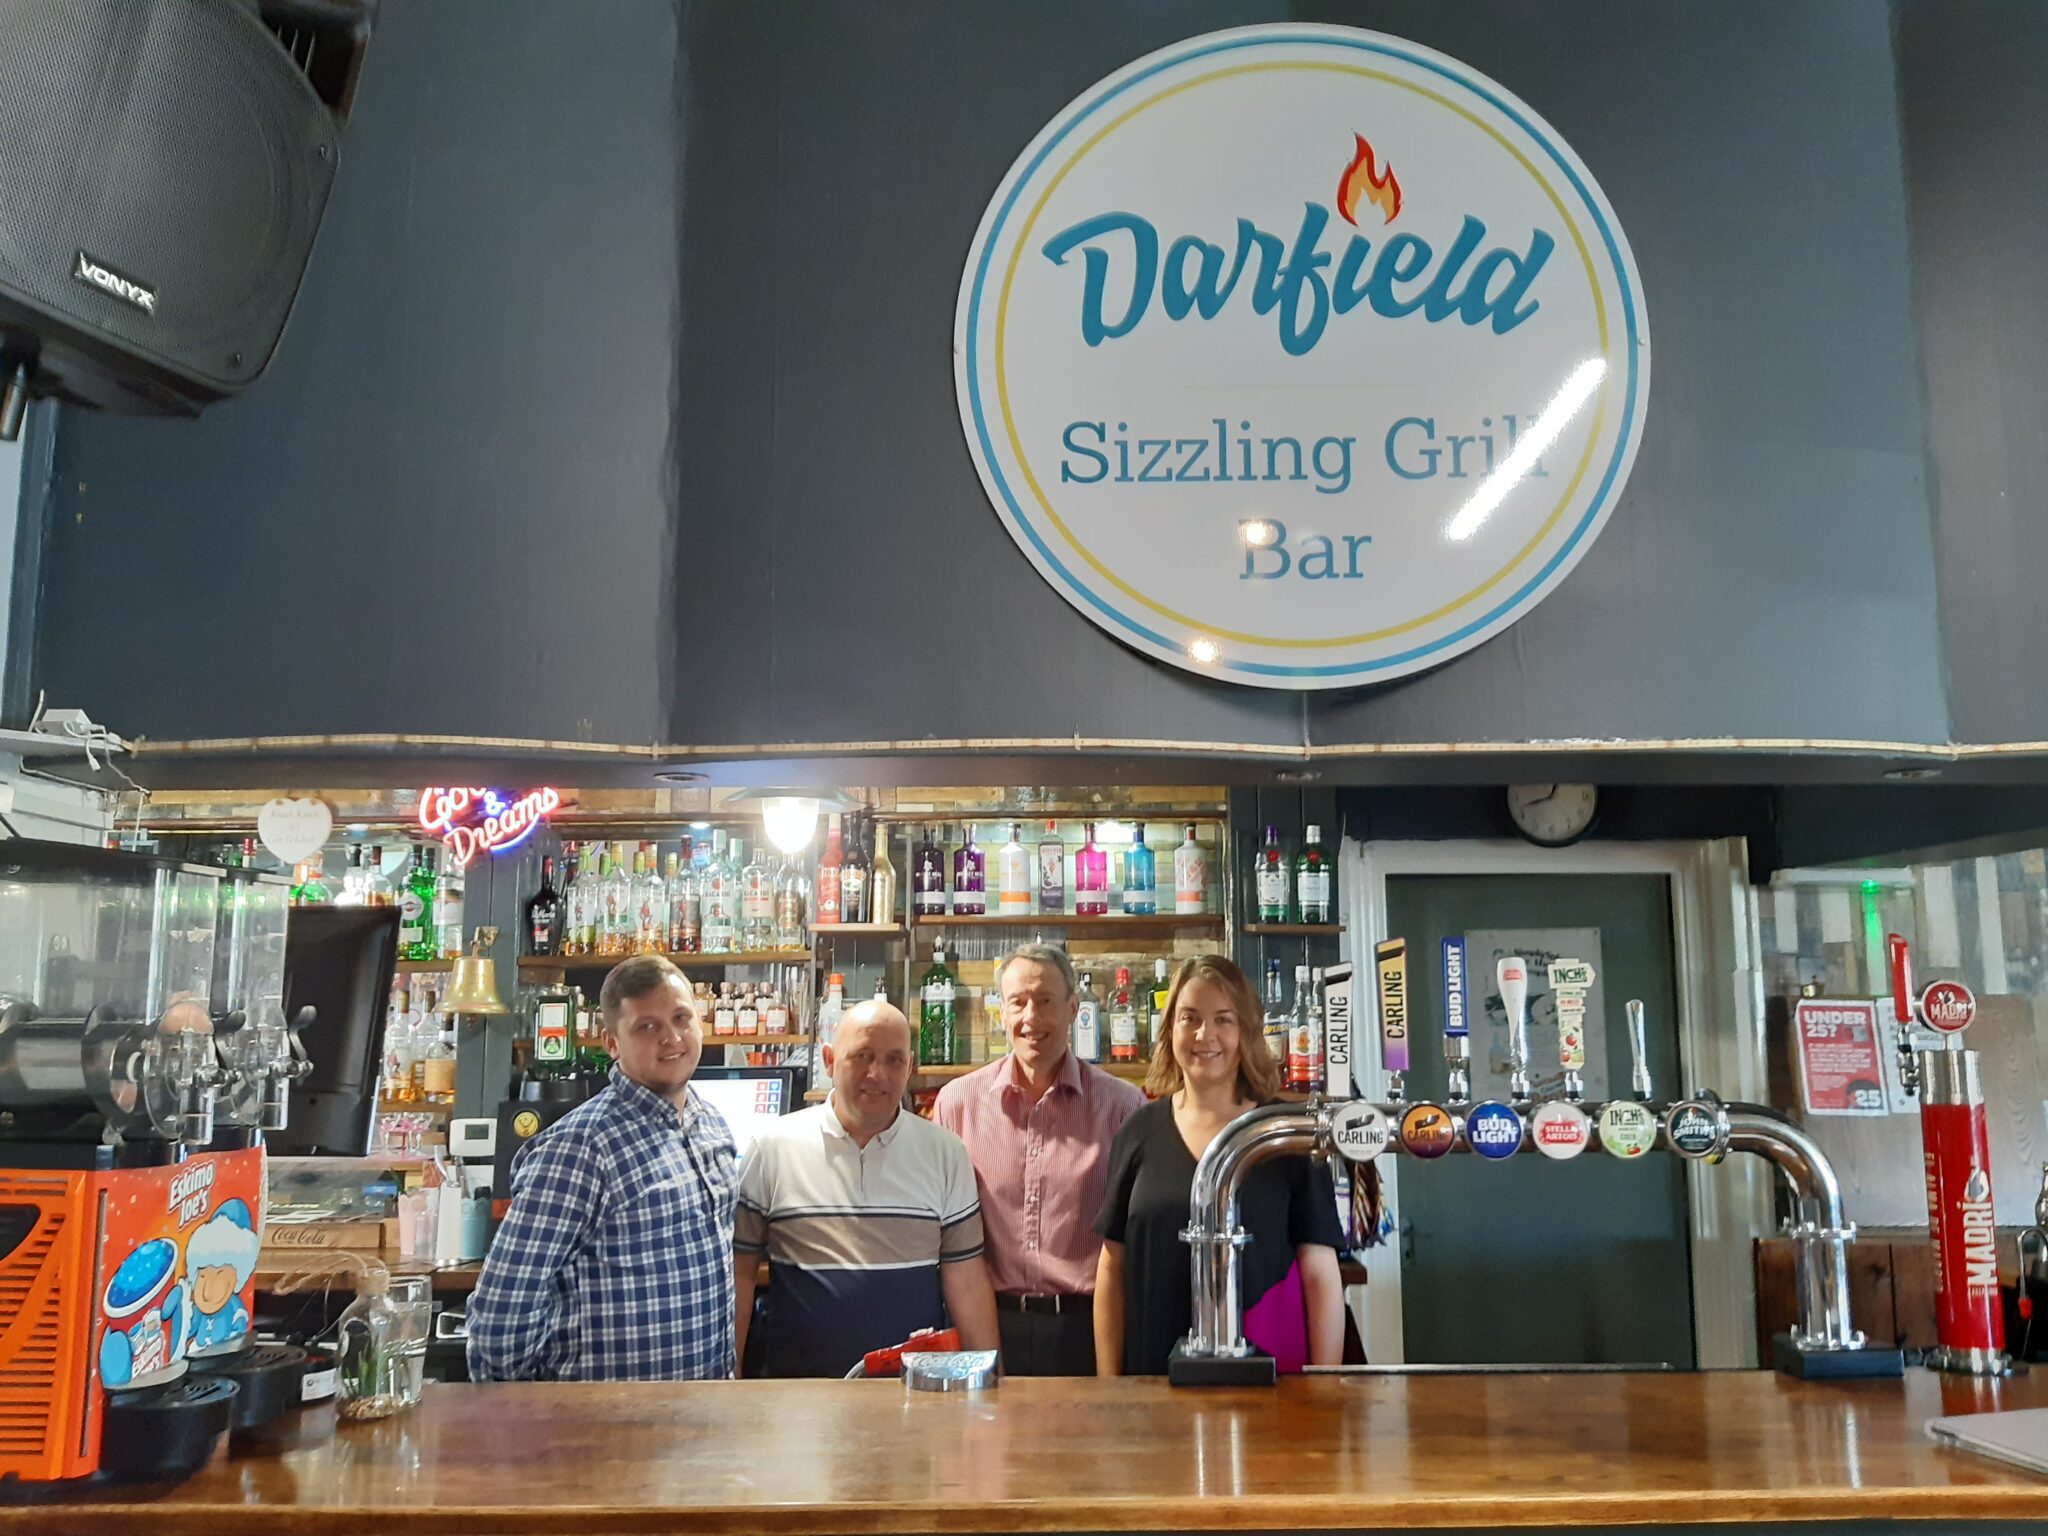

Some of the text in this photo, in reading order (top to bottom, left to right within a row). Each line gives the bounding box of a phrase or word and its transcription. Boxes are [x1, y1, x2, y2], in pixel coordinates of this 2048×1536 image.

[80, 252, 155, 309] VONYX
[1042, 201, 1555, 357] Darfield
[1060, 418, 1356, 495] Sizzling
[1238, 518, 1371, 581] Bar
[442, 786, 560, 867] Dreams
[744, 890, 769, 898] BACADI
[1383, 970, 1406, 1039] CARLING
[1446, 944, 1463, 1027] BUD LIGHT
[1329, 996, 1348, 1065] CARLING
[1804, 1010, 1867, 1026] UNDER
[1806, 1024, 1838, 1038] 25?
[1854, 1089, 1881, 1107] 25
[1337, 1130, 1384, 1145] CARLING
[1407, 1129, 1447, 1141] CARLIN
[1472, 1130, 1518, 1144] LIGHT
[1477, 1118, 1512, 1132] BUD
[168, 1160, 215, 1213] Eskimo
[179, 1189, 210, 1230] Joe's
